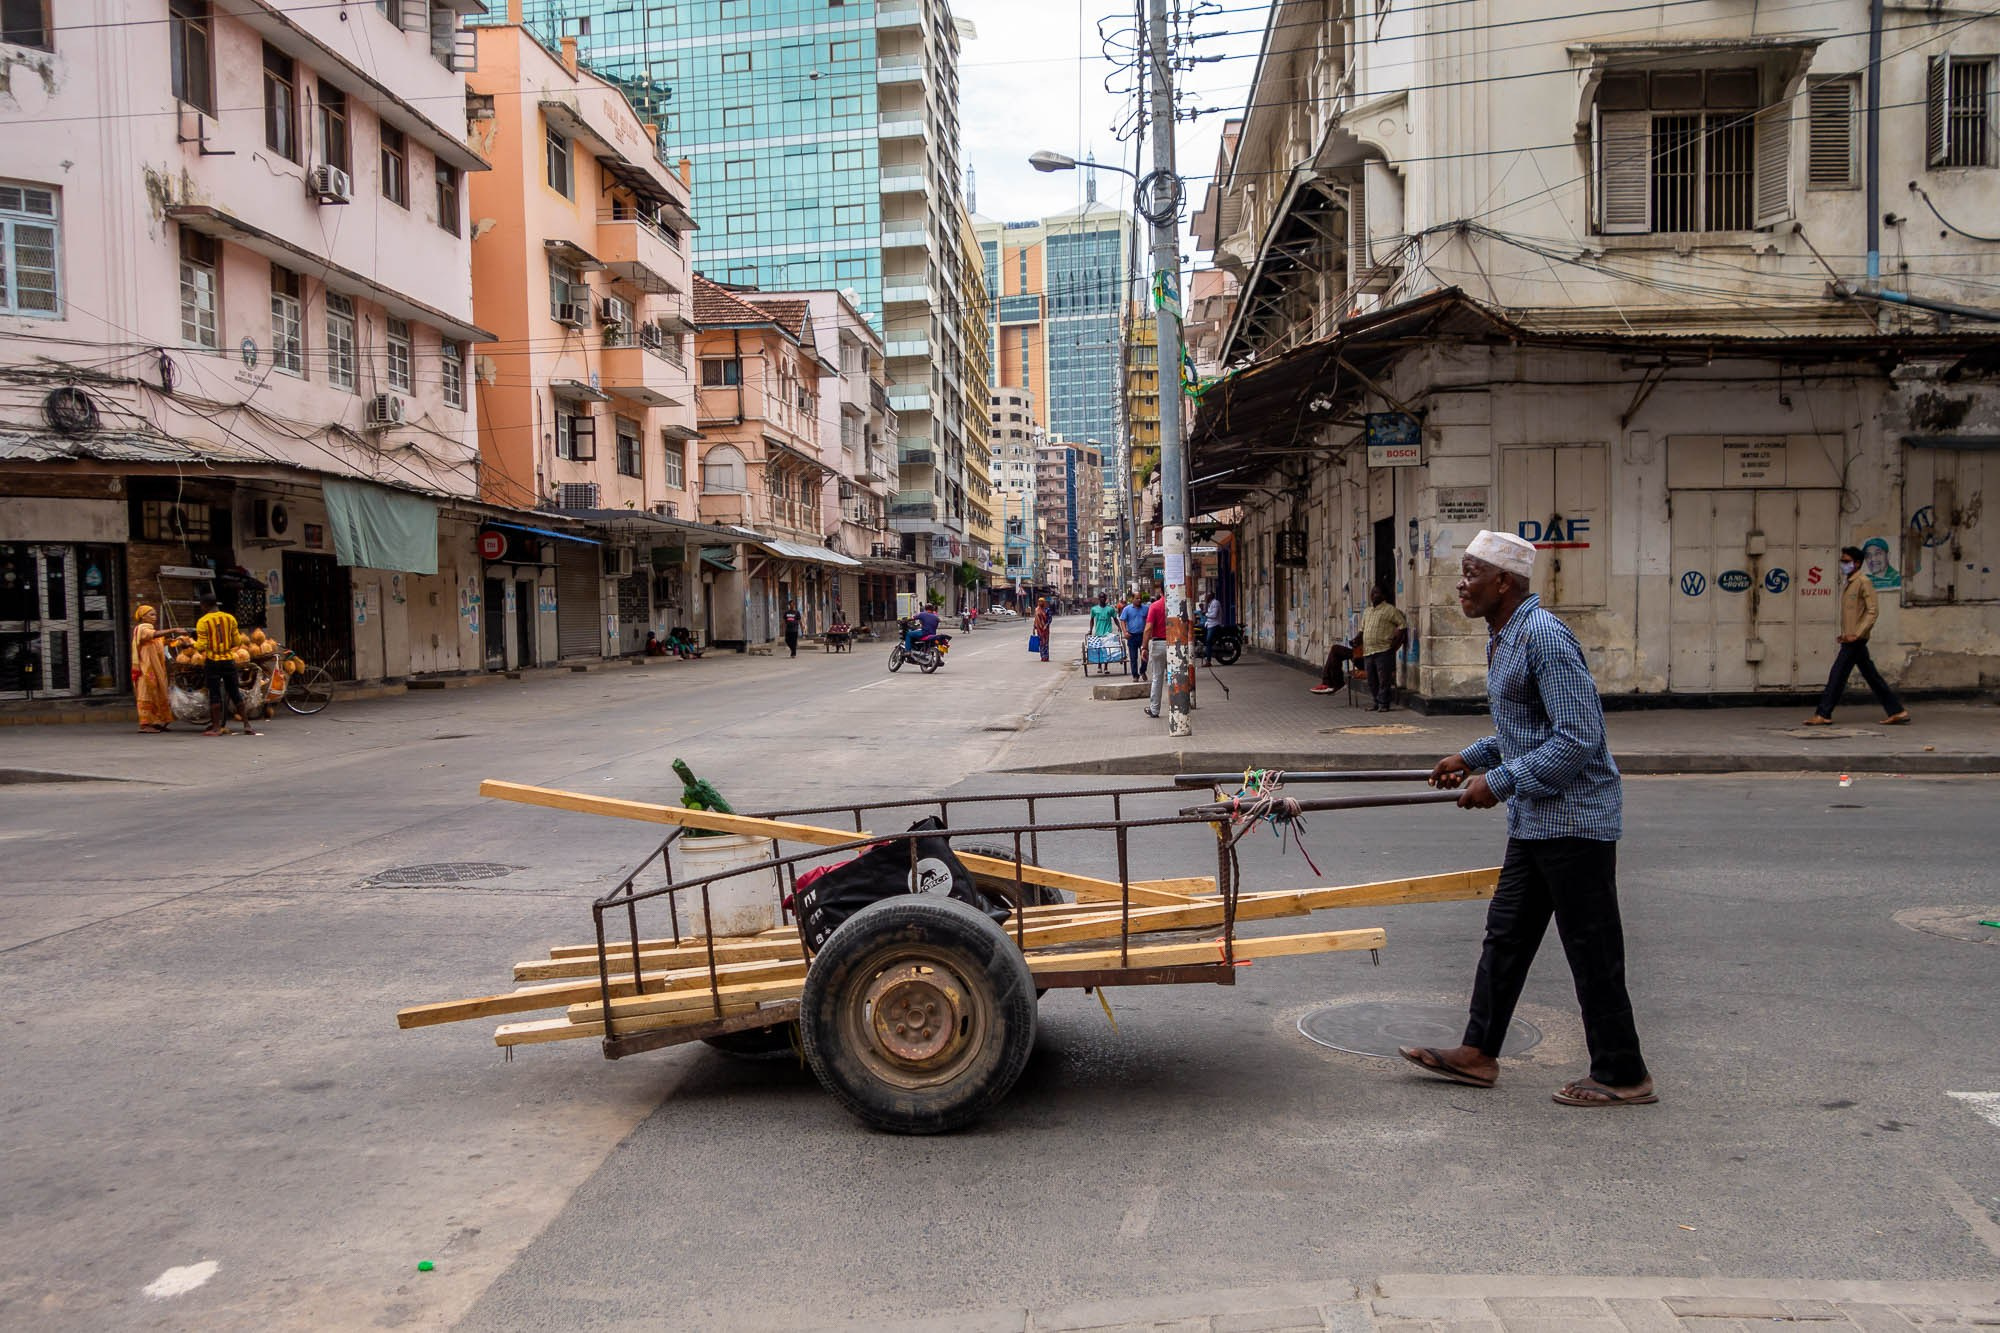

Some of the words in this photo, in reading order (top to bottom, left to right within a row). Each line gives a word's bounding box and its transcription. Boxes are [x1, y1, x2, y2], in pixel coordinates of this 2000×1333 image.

[1386, 449, 1417, 457] BOSCH
[1518, 518, 1590, 542] DAF
[1801, 588, 1831, 596] SUZUKI
[922, 872, 949, 891] ORCA
